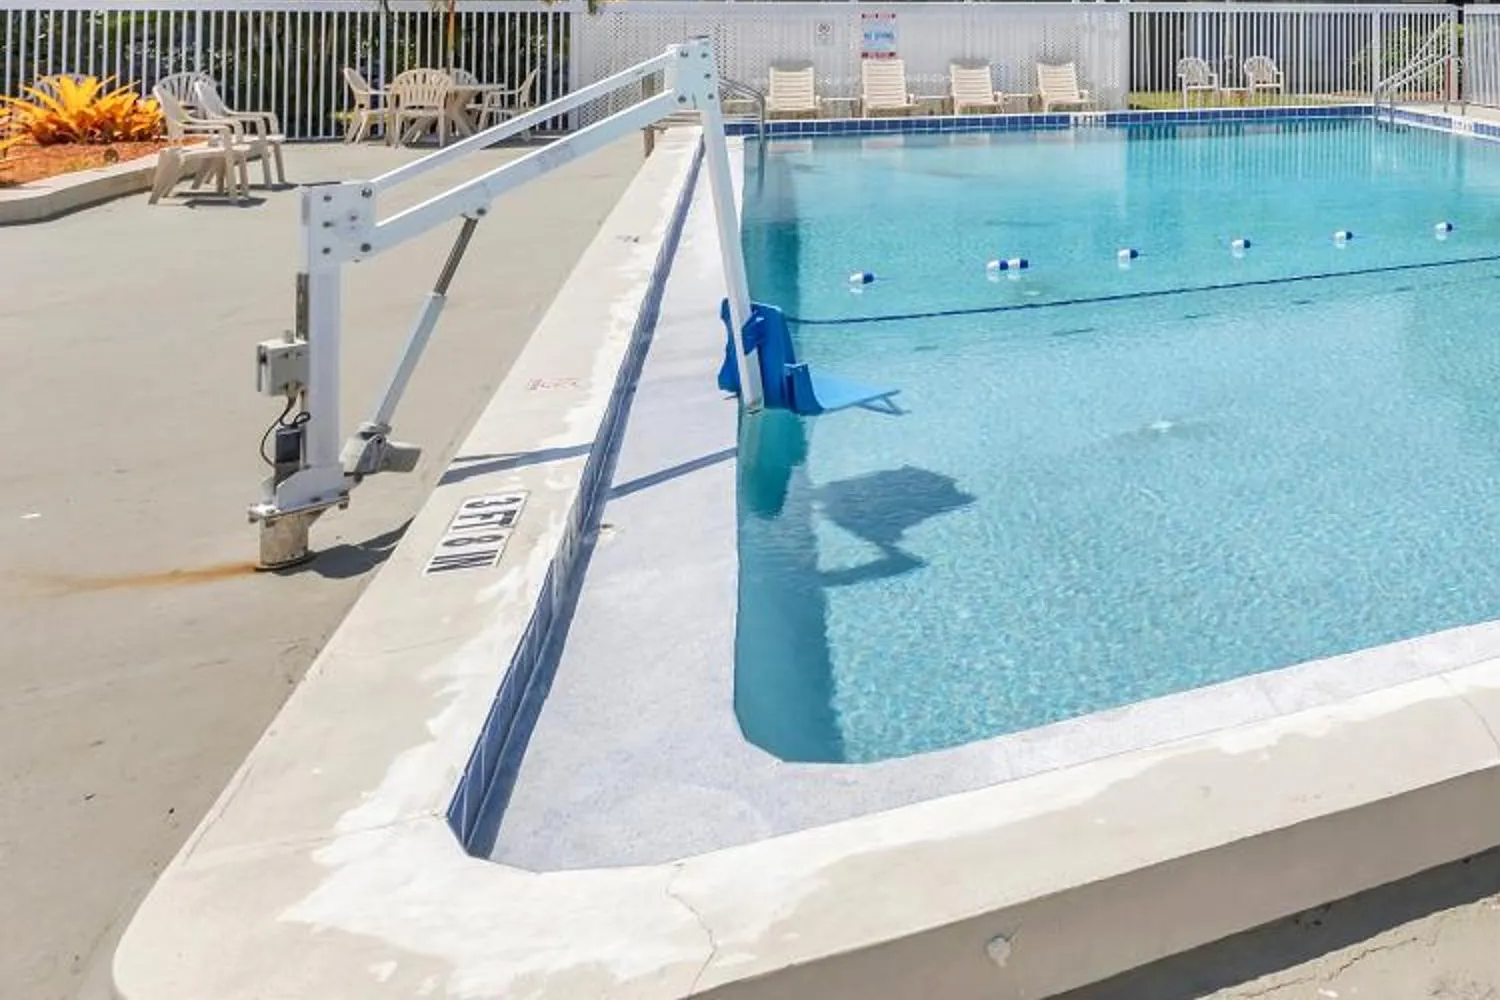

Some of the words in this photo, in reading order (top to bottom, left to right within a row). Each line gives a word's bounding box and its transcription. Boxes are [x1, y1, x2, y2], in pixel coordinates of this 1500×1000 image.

[463, 497, 523, 509] 3
[452, 509, 518, 530] FT
[441, 534, 505, 547] 8
[426, 549, 499, 573] IN
